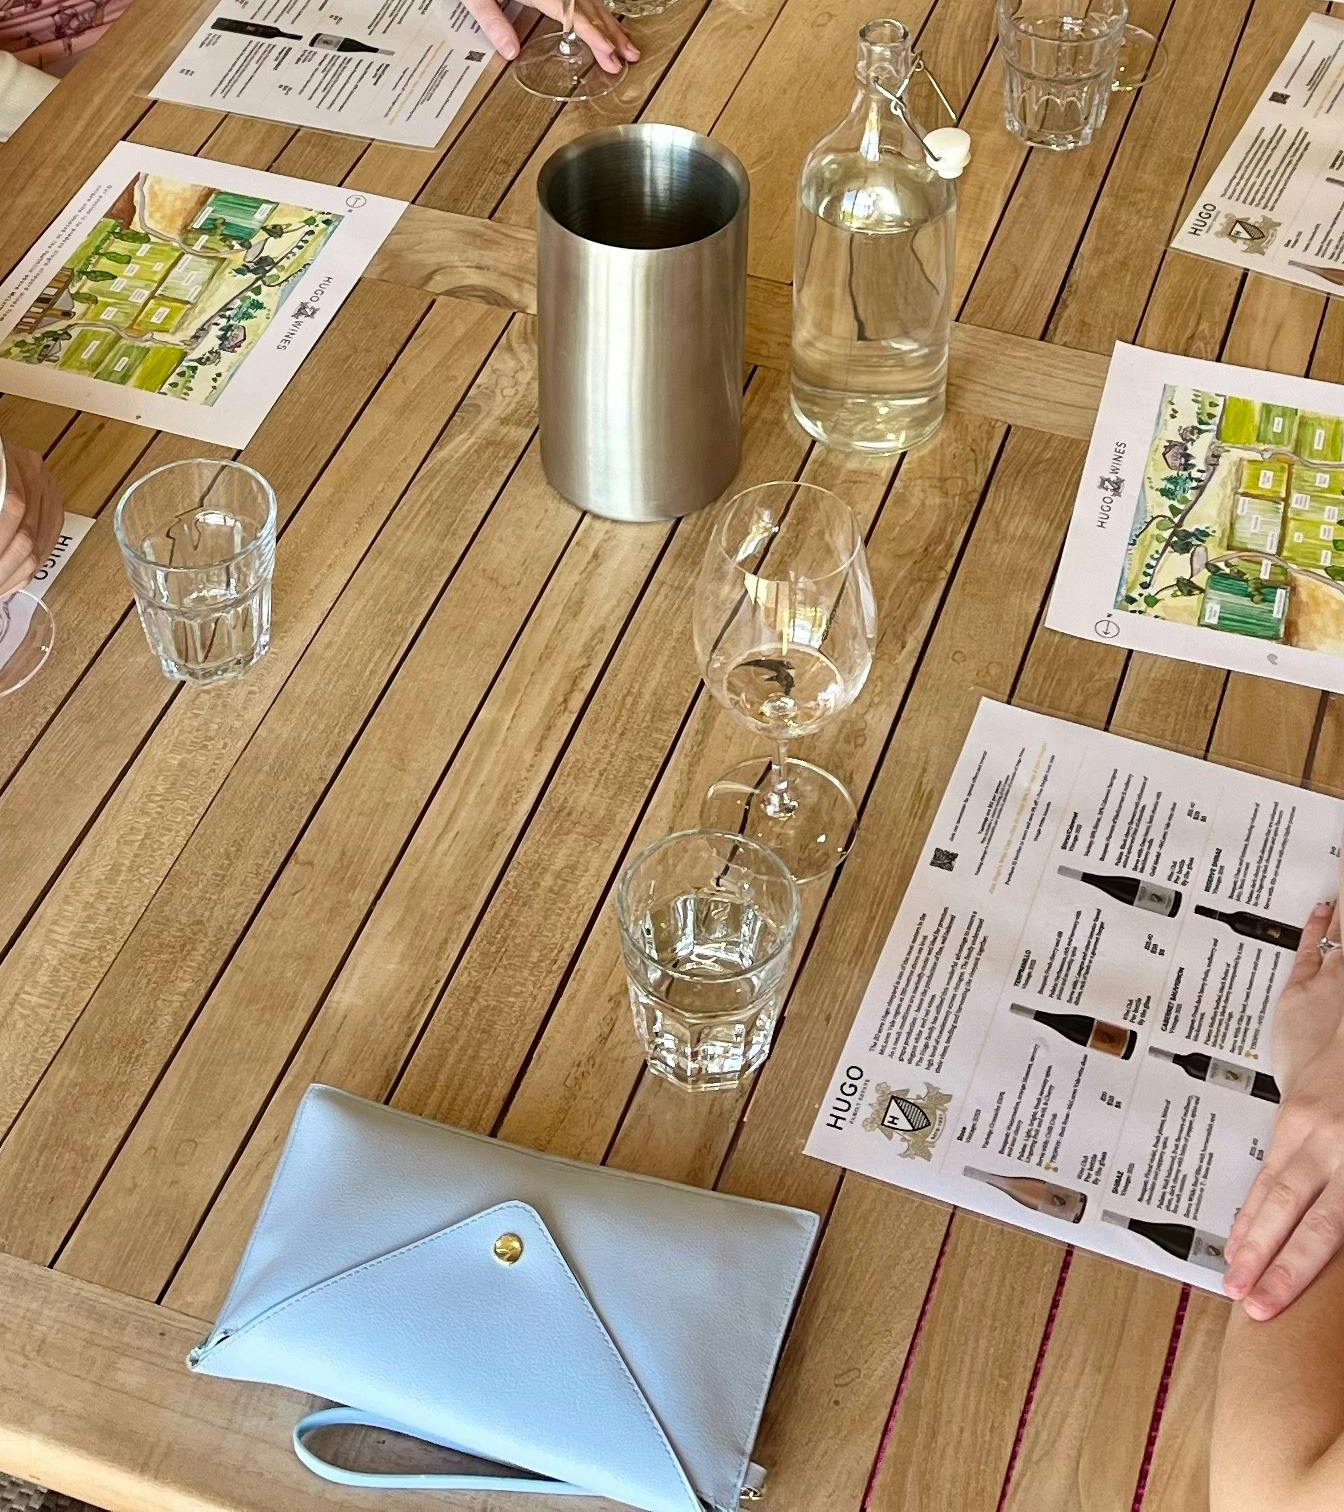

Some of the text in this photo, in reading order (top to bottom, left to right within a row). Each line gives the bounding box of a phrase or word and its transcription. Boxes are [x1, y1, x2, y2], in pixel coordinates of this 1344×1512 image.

[1188, 203, 1216, 236] HUGO
[276, 276, 333, 350] HUGO WINES
[1096, 441, 1126, 529] HUGO WINES
[825, 1065, 863, 1130] HUGO
[887, 1115, 899, 1125] H
